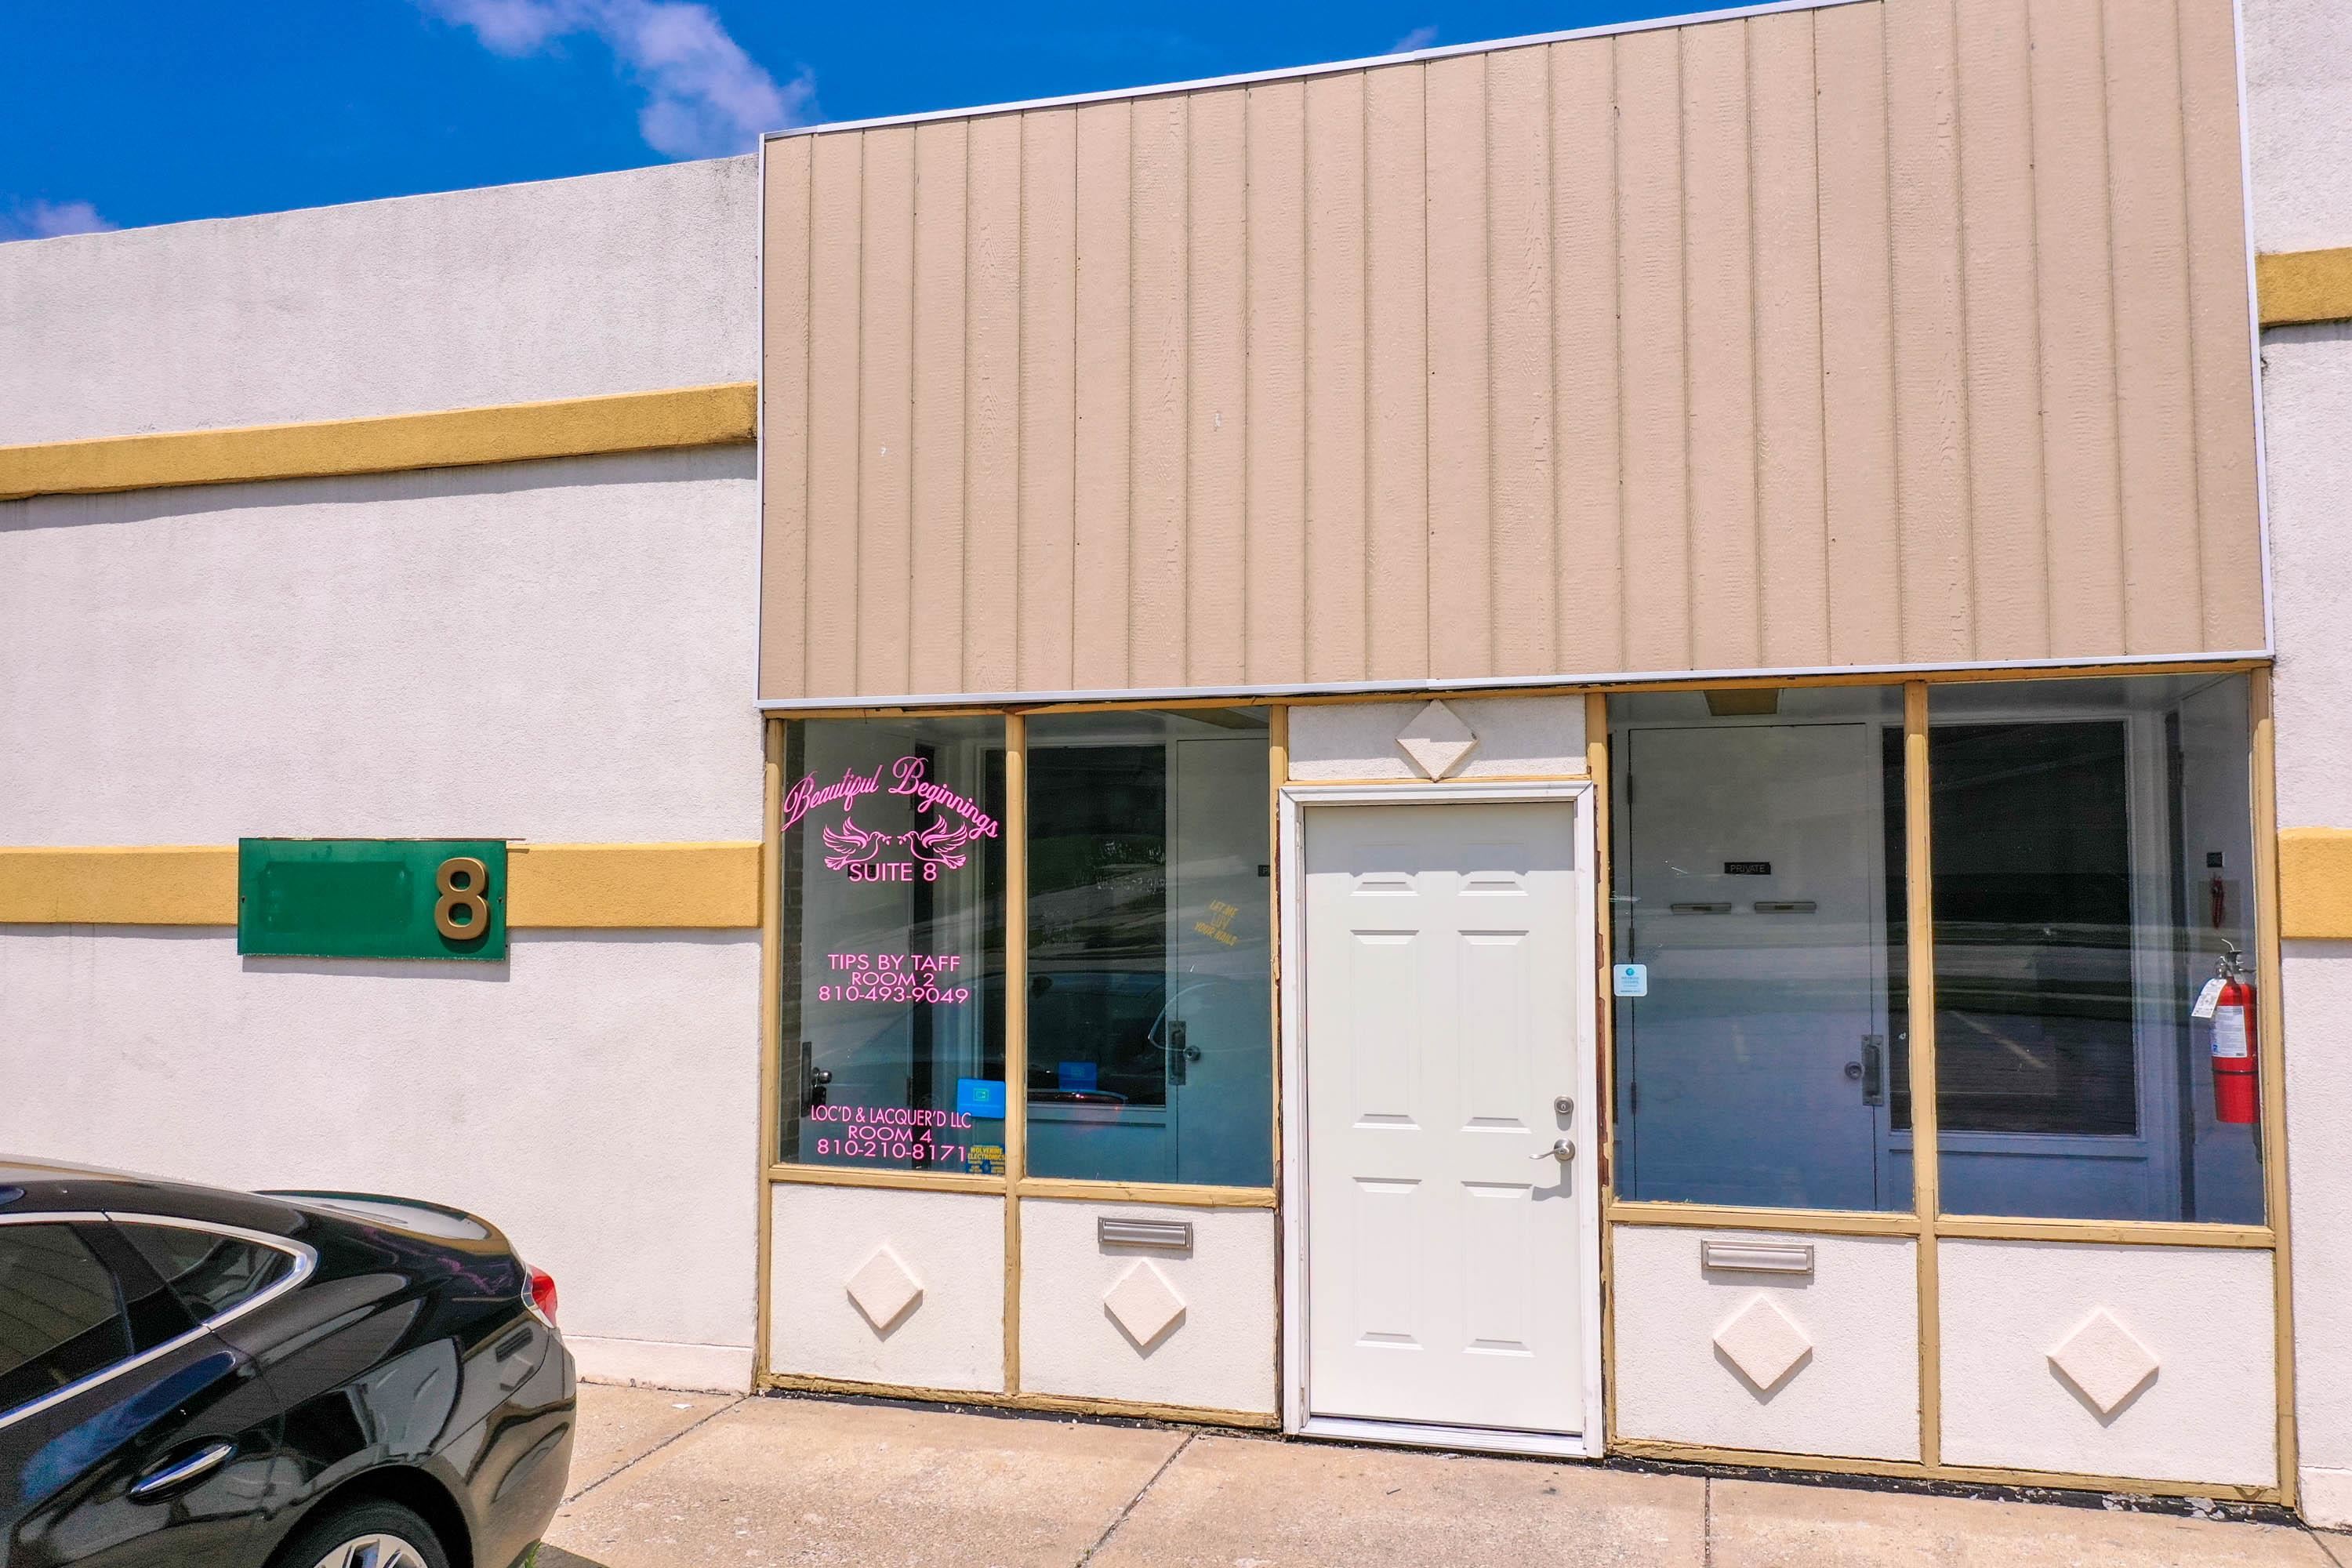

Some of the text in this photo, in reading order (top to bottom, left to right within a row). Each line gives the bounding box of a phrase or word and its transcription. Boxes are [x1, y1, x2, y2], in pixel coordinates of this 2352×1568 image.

[782, 755, 998, 840] Beautiful Beginnings
[849, 862, 938, 882] SUITE 8
[1730, 864, 1766, 873] PRIVATE
[434, 857, 490, 940] 8
[827, 954, 961, 972] TIPS BY TAFF
[851, 971, 935, 987] ROOM 2
[818, 985, 969, 1004] 810-493-9049
[811, 1104, 972, 1129] LOC'D & LACQUER'D LLC
[848, 1124, 933, 1144] ROOM 4
[817, 1139, 967, 1163] 810-210-8171
[967, 1152, 1005, 1161] ELECTRONICS
[970, 1146, 1003, 1155] WOLVERINE
